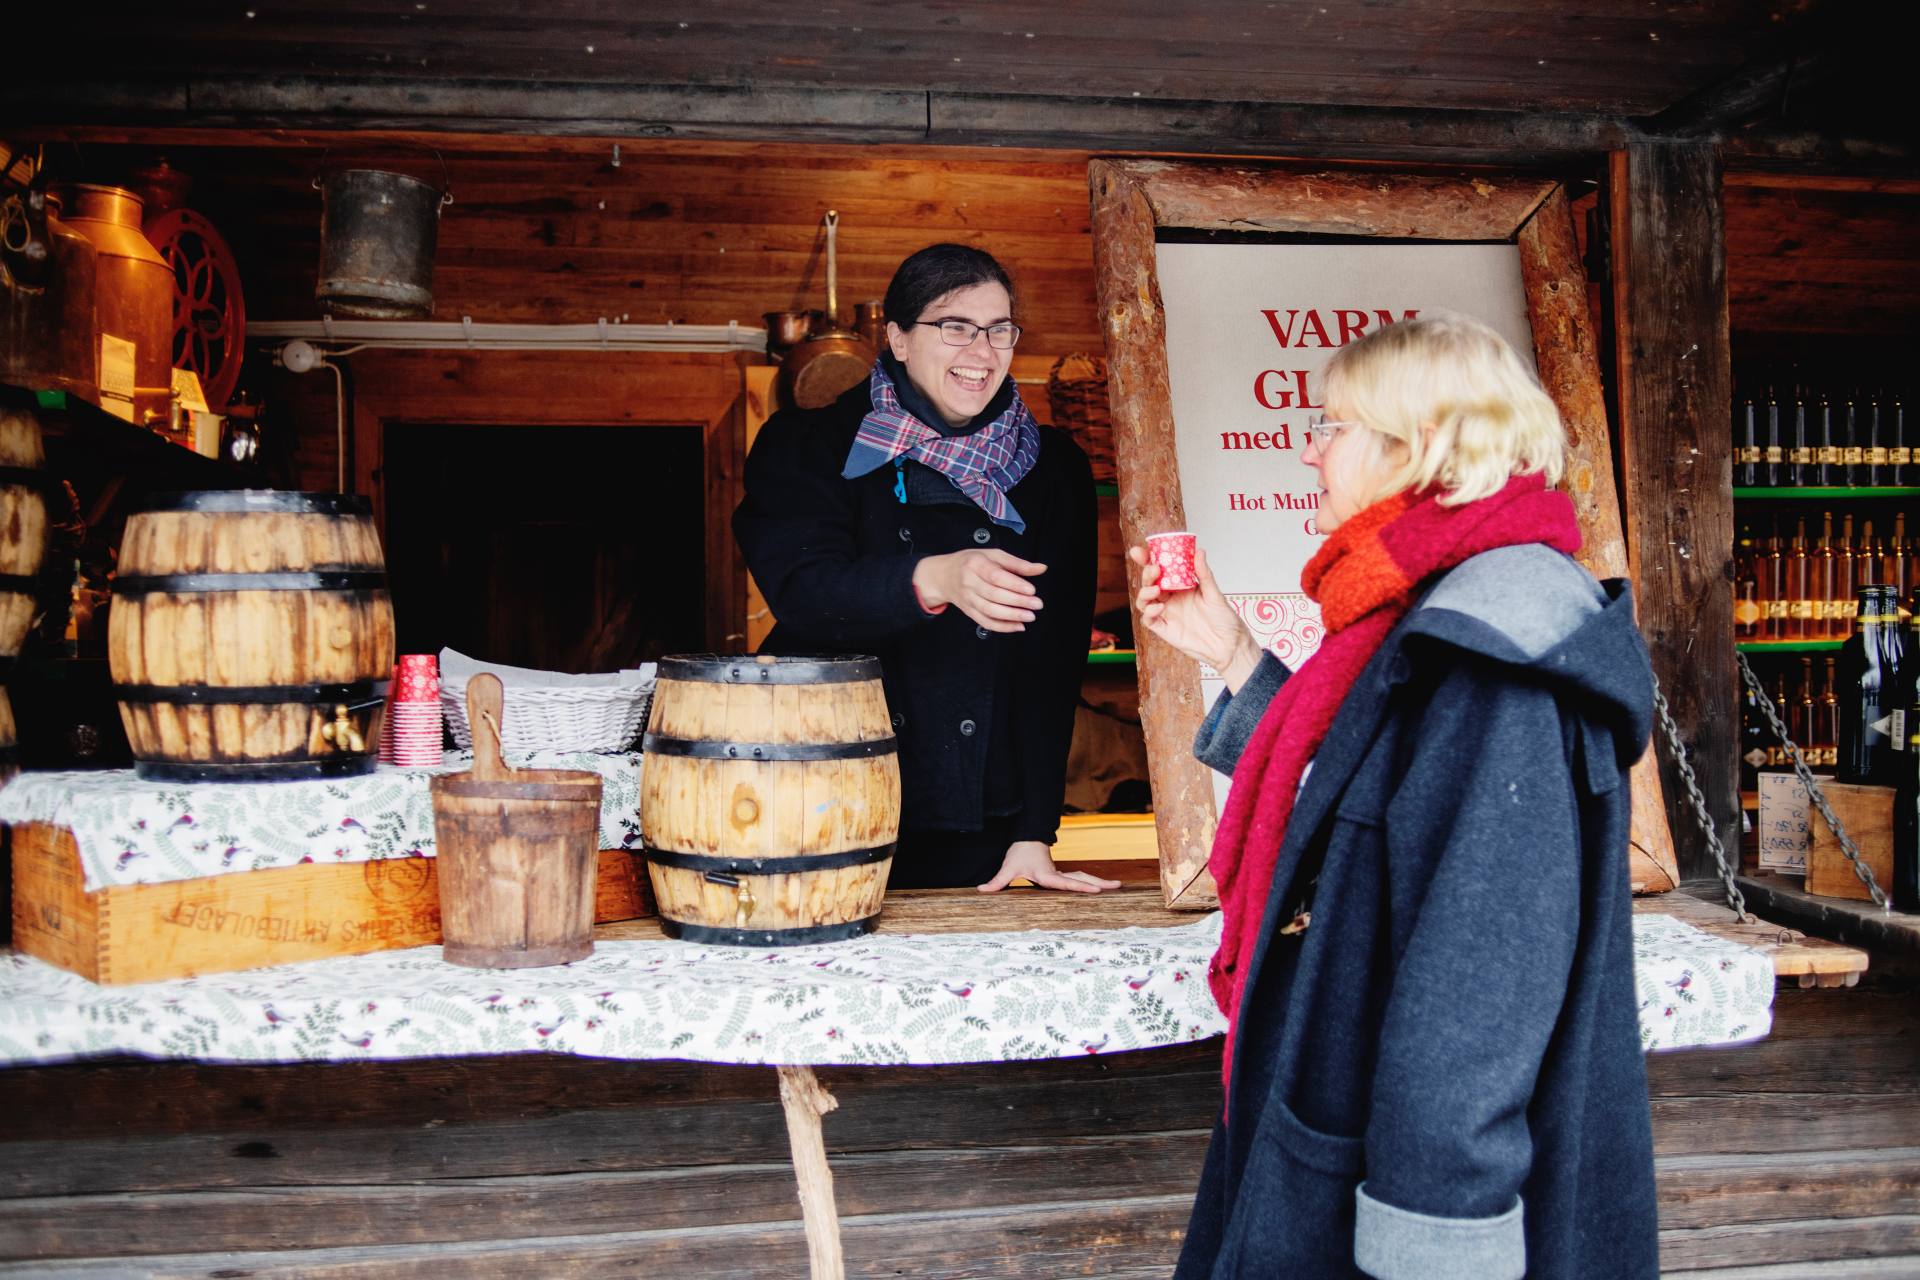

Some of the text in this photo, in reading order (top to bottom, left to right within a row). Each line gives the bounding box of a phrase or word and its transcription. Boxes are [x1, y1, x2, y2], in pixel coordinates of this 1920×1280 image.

[1253, 370, 1325, 409] GL
[1220, 424, 1293, 450] med
[1229, 493, 1319, 511] Hot Mull
